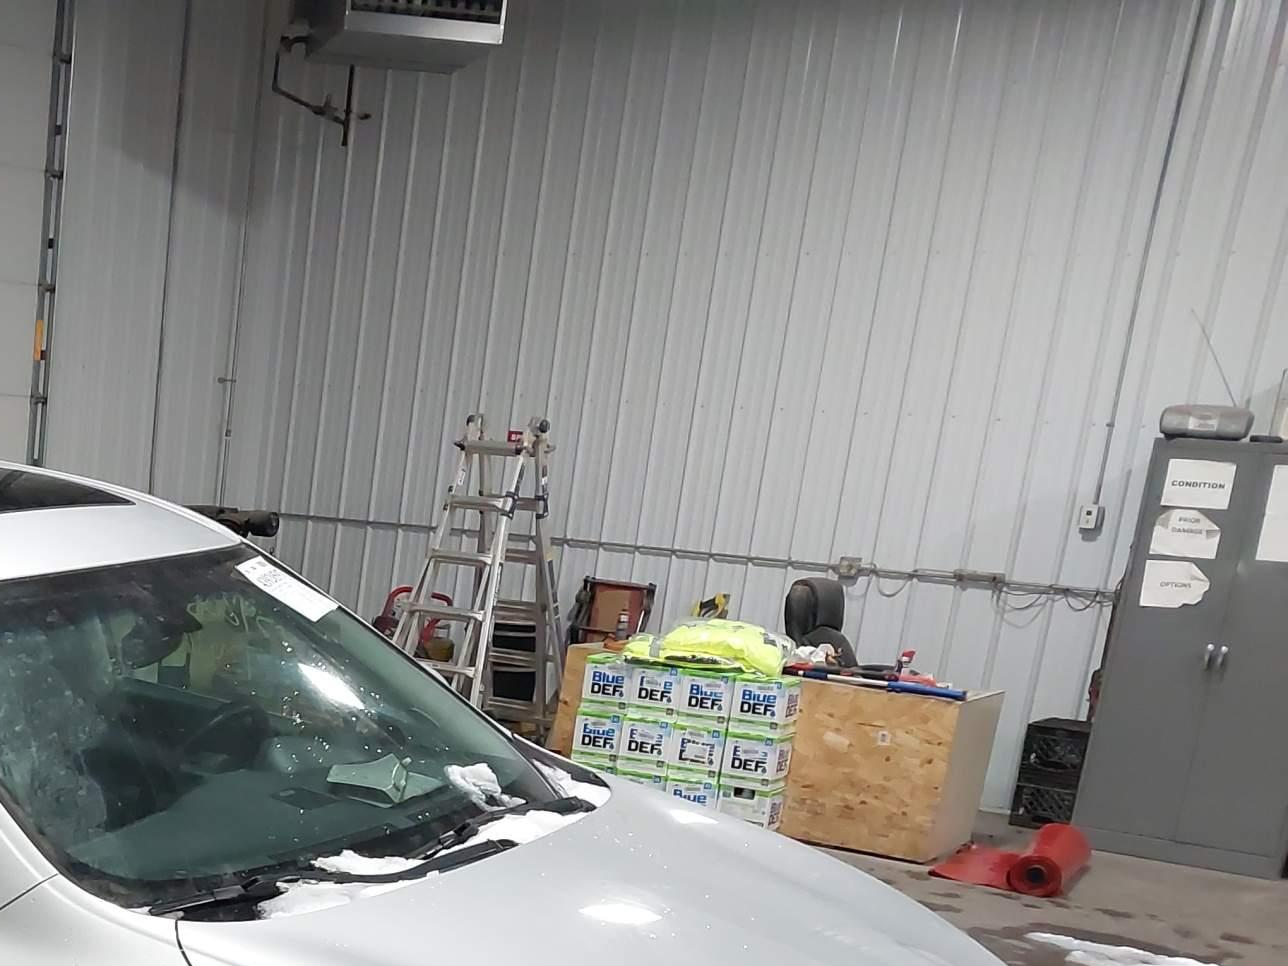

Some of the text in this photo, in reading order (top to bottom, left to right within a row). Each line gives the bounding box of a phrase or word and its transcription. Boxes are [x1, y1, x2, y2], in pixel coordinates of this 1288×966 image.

[1171, 480, 1226, 490] CONDITION
[592, 671, 624, 685] Blue
[591, 683, 623, 697] DEF
[638, 687, 672, 702] DEF
[742, 689, 777, 704] Blue
[688, 696, 722, 710] DEF
[740, 701, 776, 716] DEF
[581, 734, 615, 748] DEF
[627, 740, 663, 754] DEF
[731, 757, 767, 772] DEF
